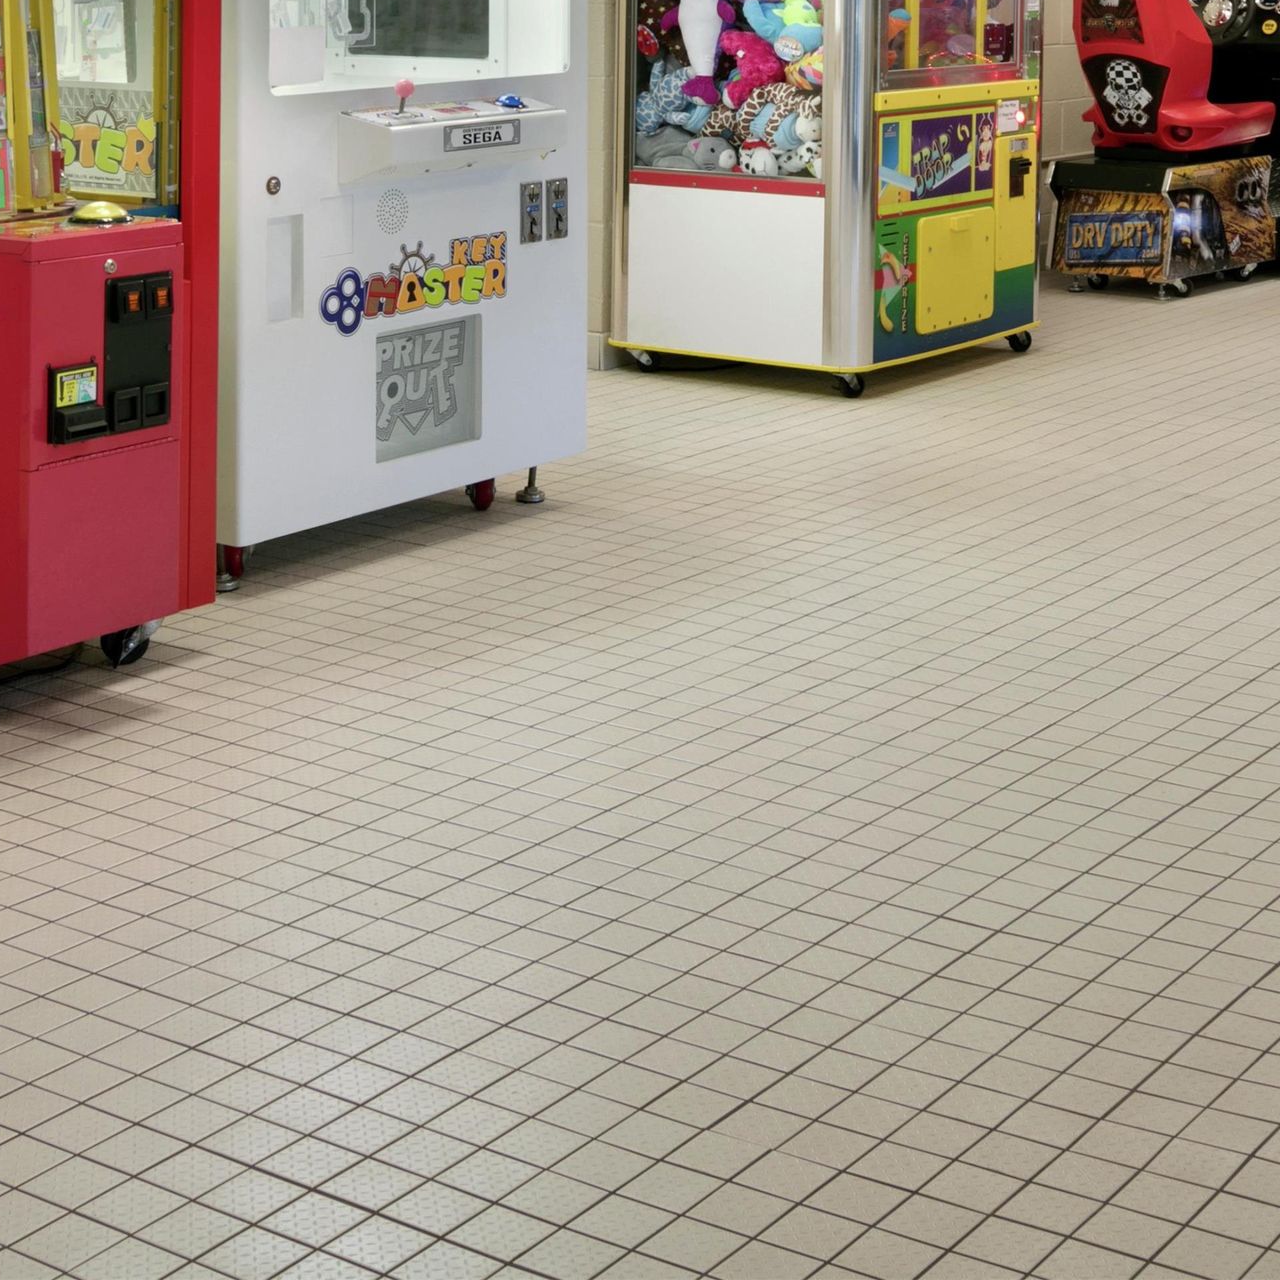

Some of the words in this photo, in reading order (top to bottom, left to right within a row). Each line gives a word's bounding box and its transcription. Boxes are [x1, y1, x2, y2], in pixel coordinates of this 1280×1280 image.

[463, 131, 502, 145] SEGA
[913, 133, 950, 169] TRAP
[914, 152, 954, 200] DOOR
[453, 234, 506, 265] KEY
[1072, 223, 1107, 248] DRV
[1111, 221, 1156, 248] DRTY
[363, 260, 506, 318] MASTER
[376, 327, 460, 370] PRIZE
[377, 361, 452, 428] OUT
